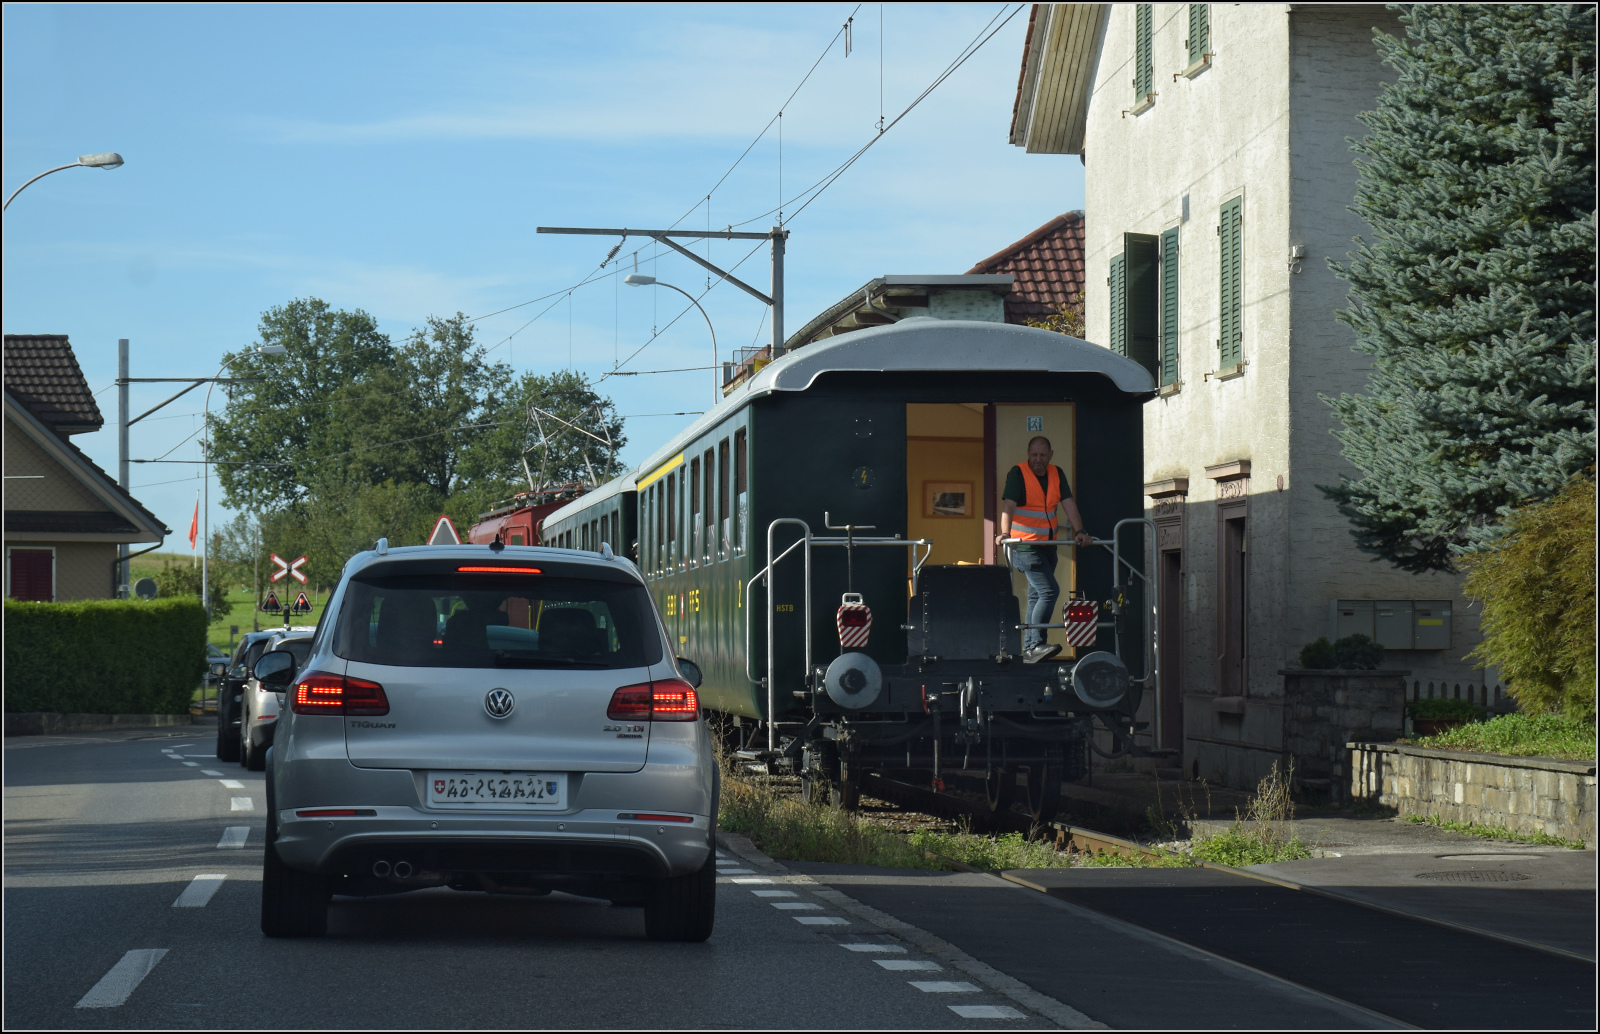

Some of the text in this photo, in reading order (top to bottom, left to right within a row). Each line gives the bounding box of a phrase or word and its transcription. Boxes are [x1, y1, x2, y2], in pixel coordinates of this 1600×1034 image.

[776, 604, 794, 612] HSTB
[350, 720, 396, 729] TIGUAN
[603, 724, 622, 732] 2.0
